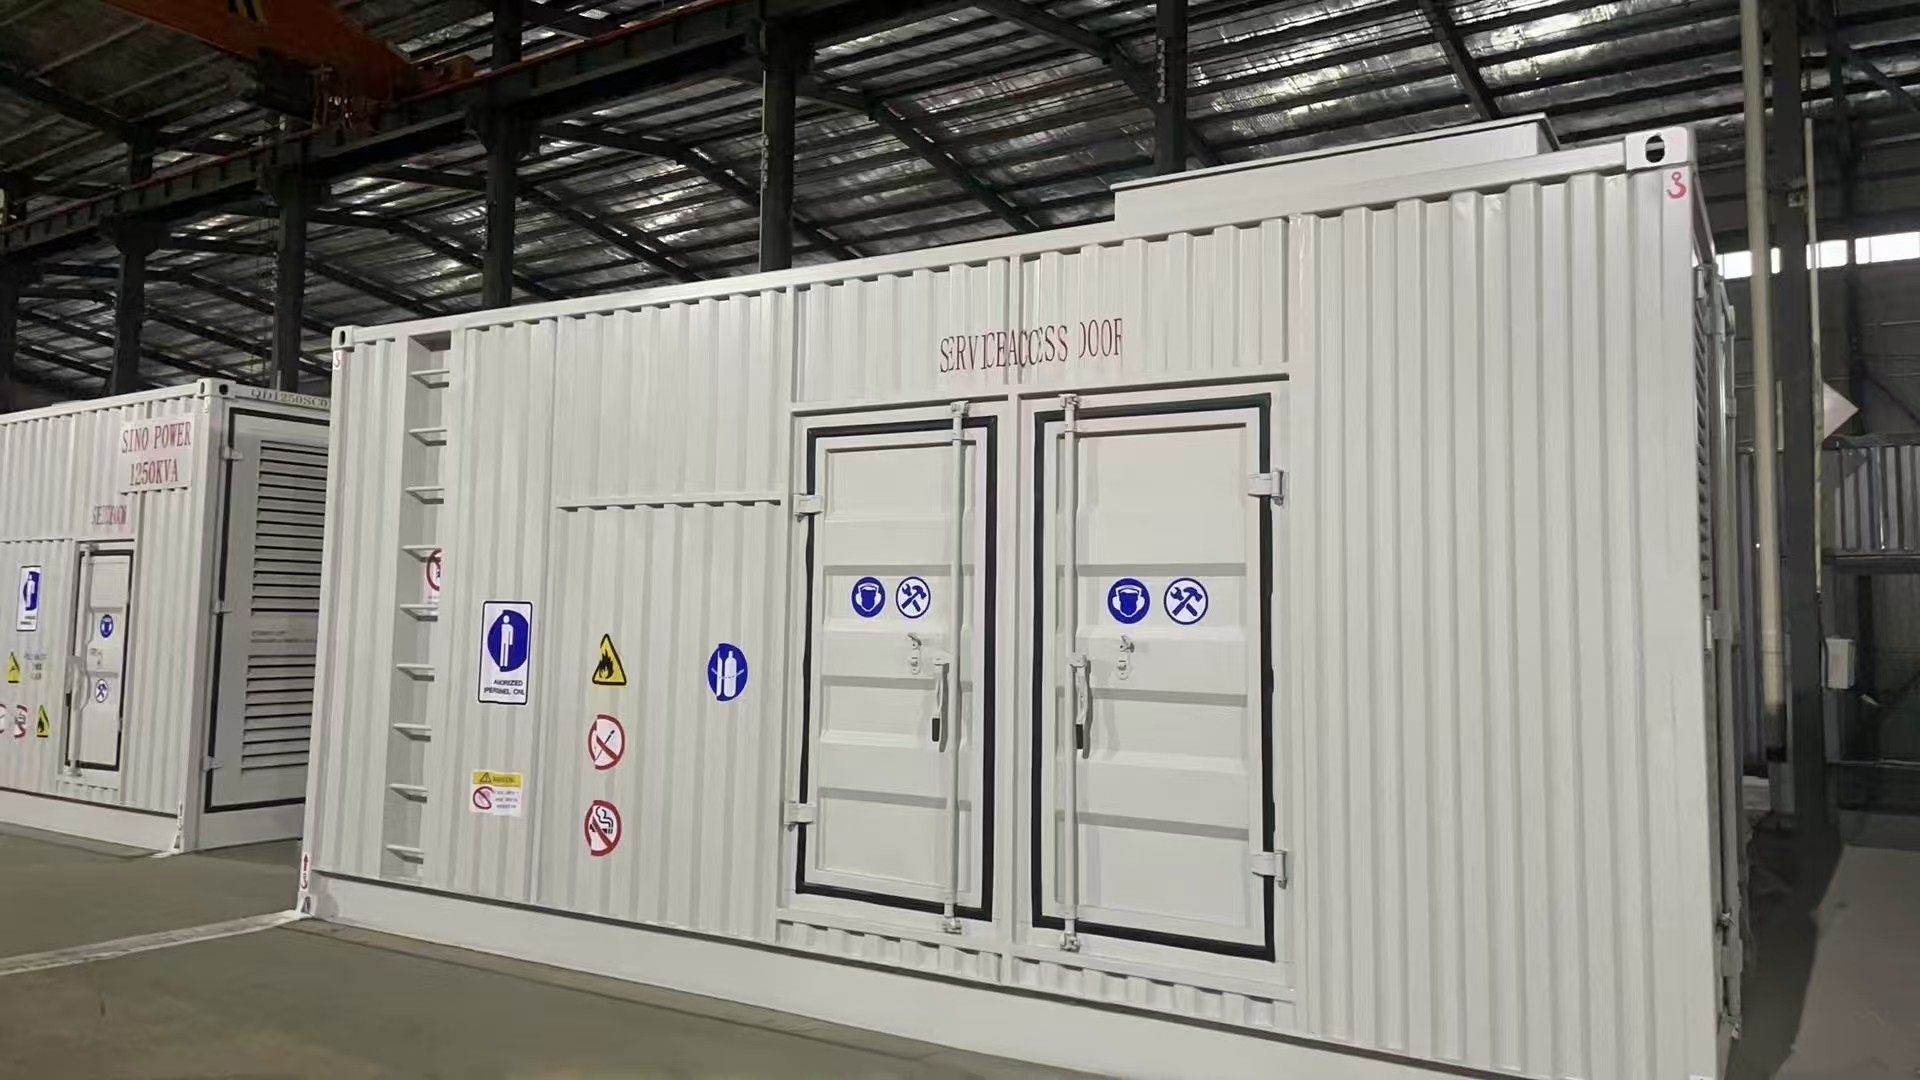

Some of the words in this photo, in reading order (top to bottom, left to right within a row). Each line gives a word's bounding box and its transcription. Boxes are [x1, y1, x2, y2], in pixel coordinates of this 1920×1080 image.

[121, 427, 149, 453] SINO
[153, 421, 192, 449] POWER
[129, 458, 179, 486] 1250KVA
